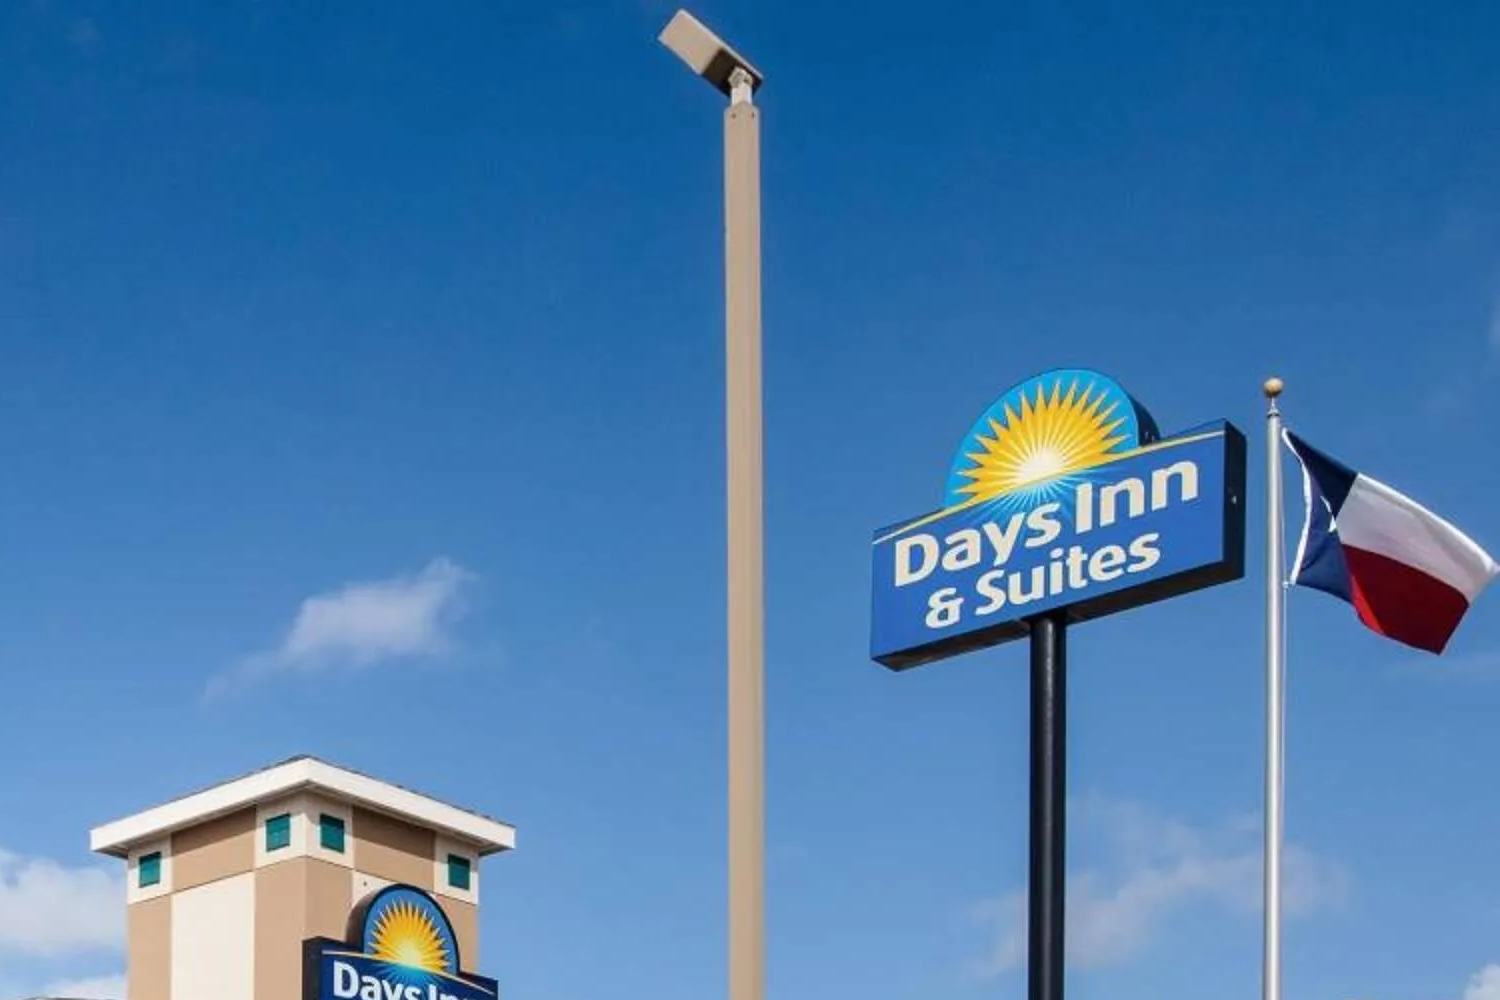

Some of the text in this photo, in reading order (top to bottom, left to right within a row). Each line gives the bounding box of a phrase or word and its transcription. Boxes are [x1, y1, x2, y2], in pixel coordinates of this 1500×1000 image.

[894, 460, 1199, 587] Days Inn
[925, 532, 1161, 629] & Suites
